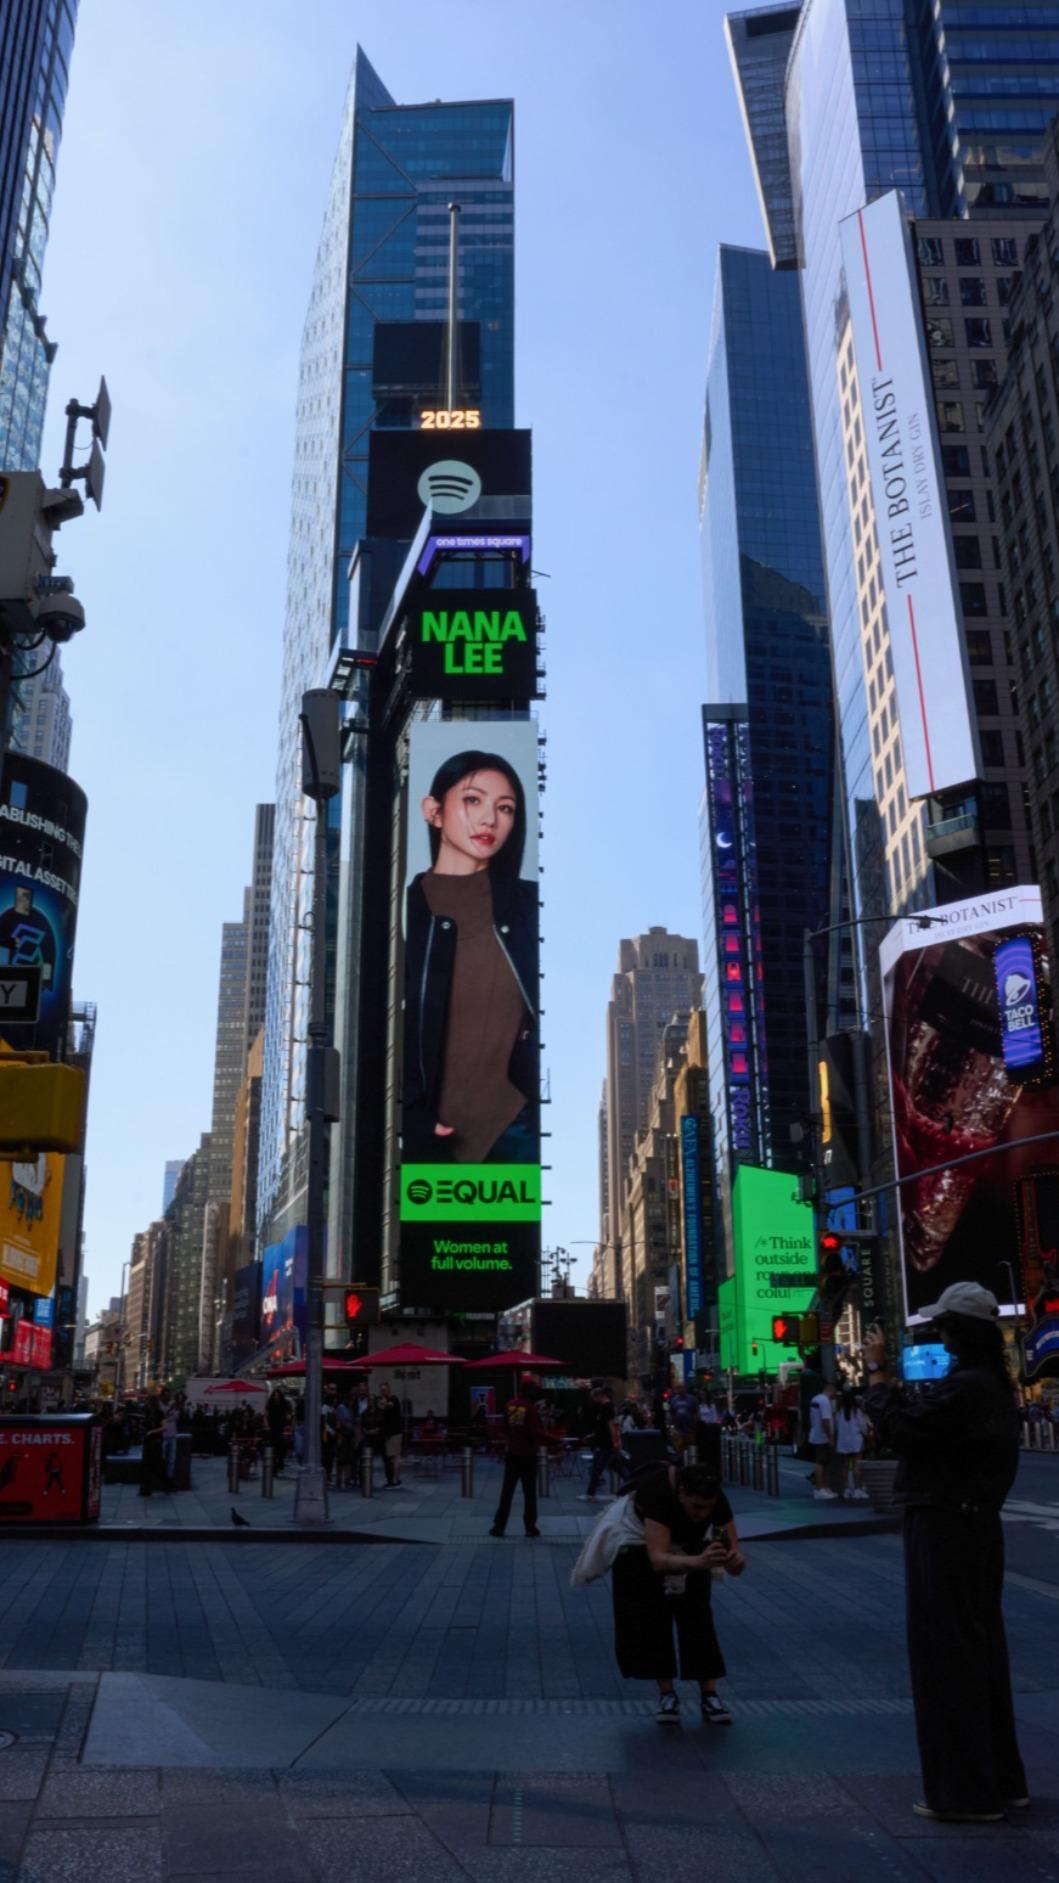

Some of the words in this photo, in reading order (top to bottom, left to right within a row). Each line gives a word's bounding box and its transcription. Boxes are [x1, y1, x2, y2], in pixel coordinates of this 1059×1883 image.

[421, 410, 481, 430] 2025
[906, 411, 920, 441] GIN
[871, 378, 910, 519] BOTANIST
[911, 445, 928, 474] DRY
[436, 538, 455, 546] one
[456, 537, 485, 546] times
[487, 538, 523, 548] square
[890, 522, 918, 590] THE
[421, 610, 528, 643] NANA
[444, 643, 504, 674] LEE
[940, 897, 1016, 926] BOTANIST
[1003, 1004, 1035, 1021] TACO
[1007, 1016, 1039, 1033] BELL
[437, 1180, 536, 1205] EQUAL
[433, 1240, 491, 1254] Women
[493, 1242, 508, 1254] at
[768, 1236, 812, 1249] Think
[432, 1256, 454, 1270] full
[455, 1256, 513, 1270] volume.
[754, 1252, 808, 1265] outside
[861, 1248, 876, 1308] SQUARE
[11, 1432, 76, 1447] CHARTS.
